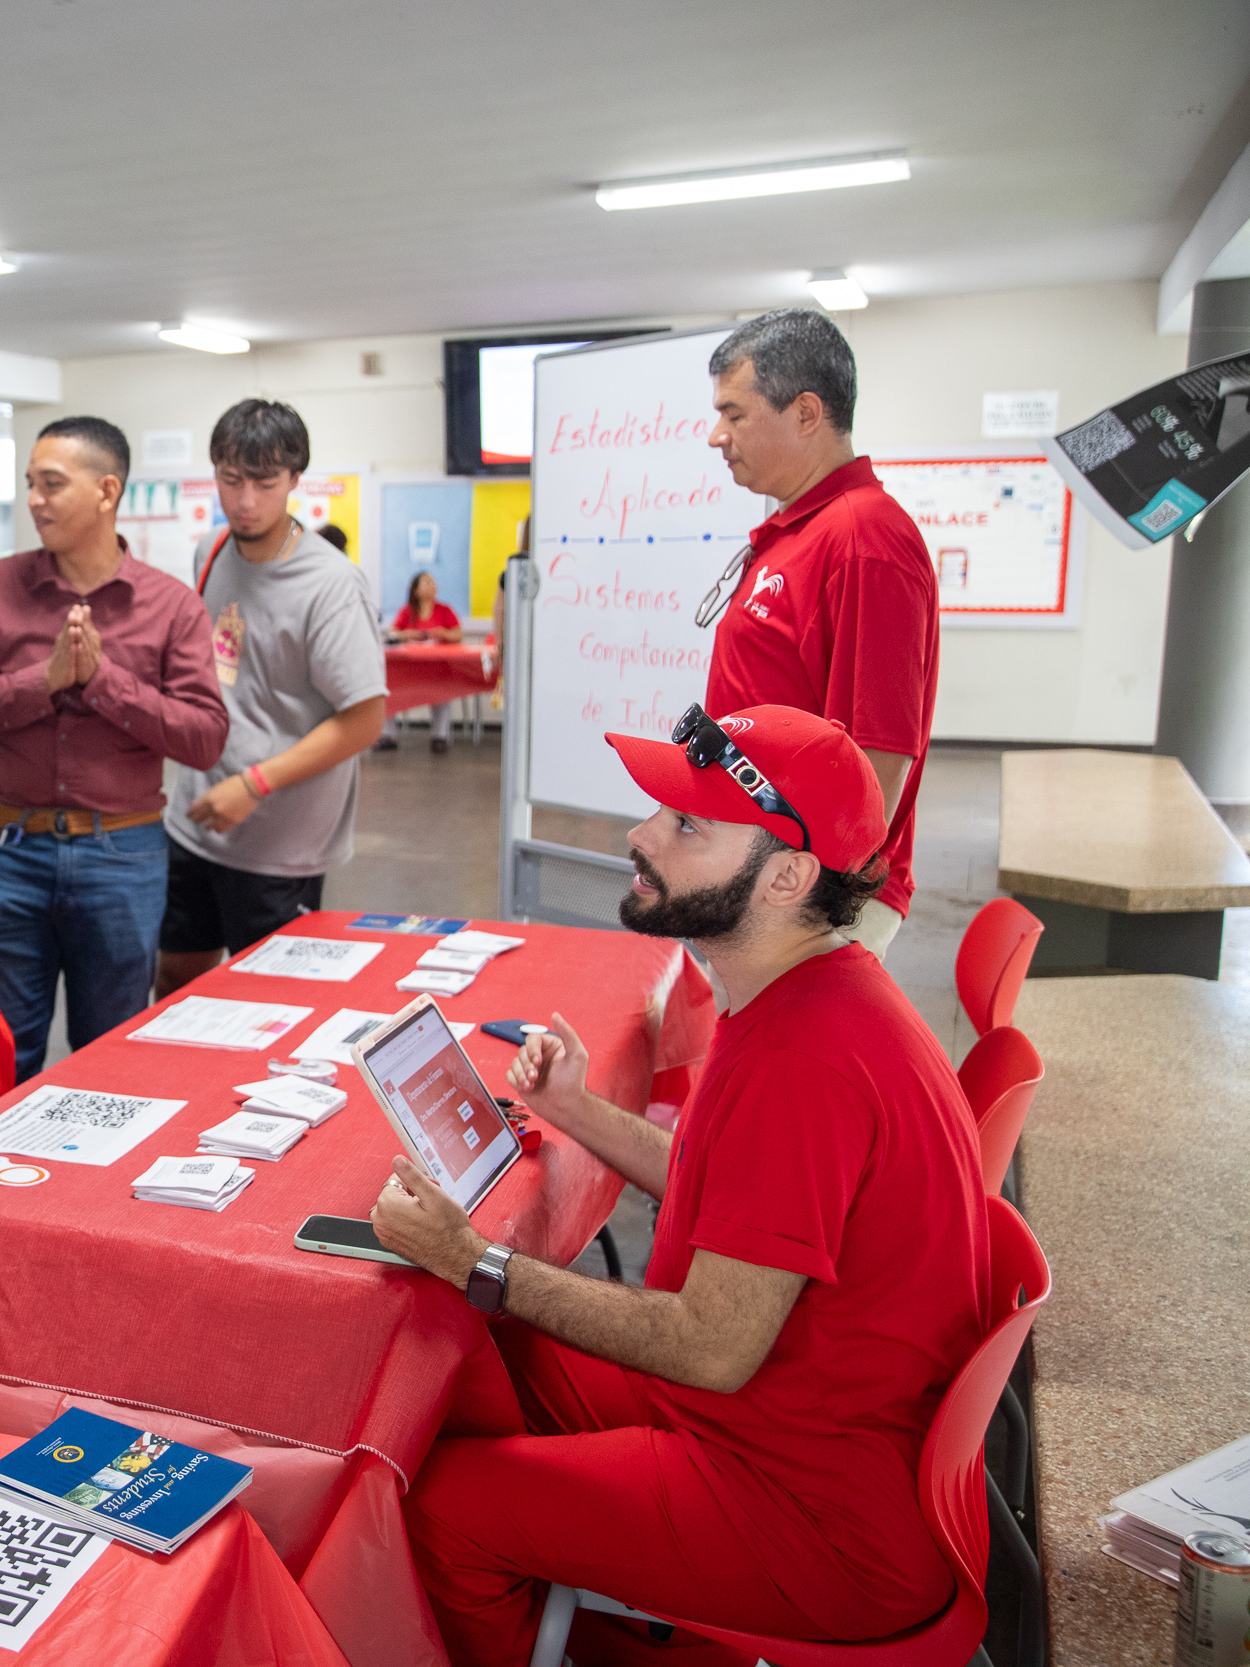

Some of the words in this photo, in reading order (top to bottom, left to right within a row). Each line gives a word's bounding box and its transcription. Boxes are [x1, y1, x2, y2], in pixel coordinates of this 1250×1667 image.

[579, 467, 722, 540] Aplicada
[910, 511, 990, 528] NLACE
[542, 551, 682, 612] Sistemas
[581, 690, 604, 724] de
[166, 1464, 177, 1475] for
[171, 1452, 210, 1482] Saving
[102, 1467, 166, 1513] Students
[163, 1478, 175, 1491] and
[119, 1486, 172, 1521] Investing
